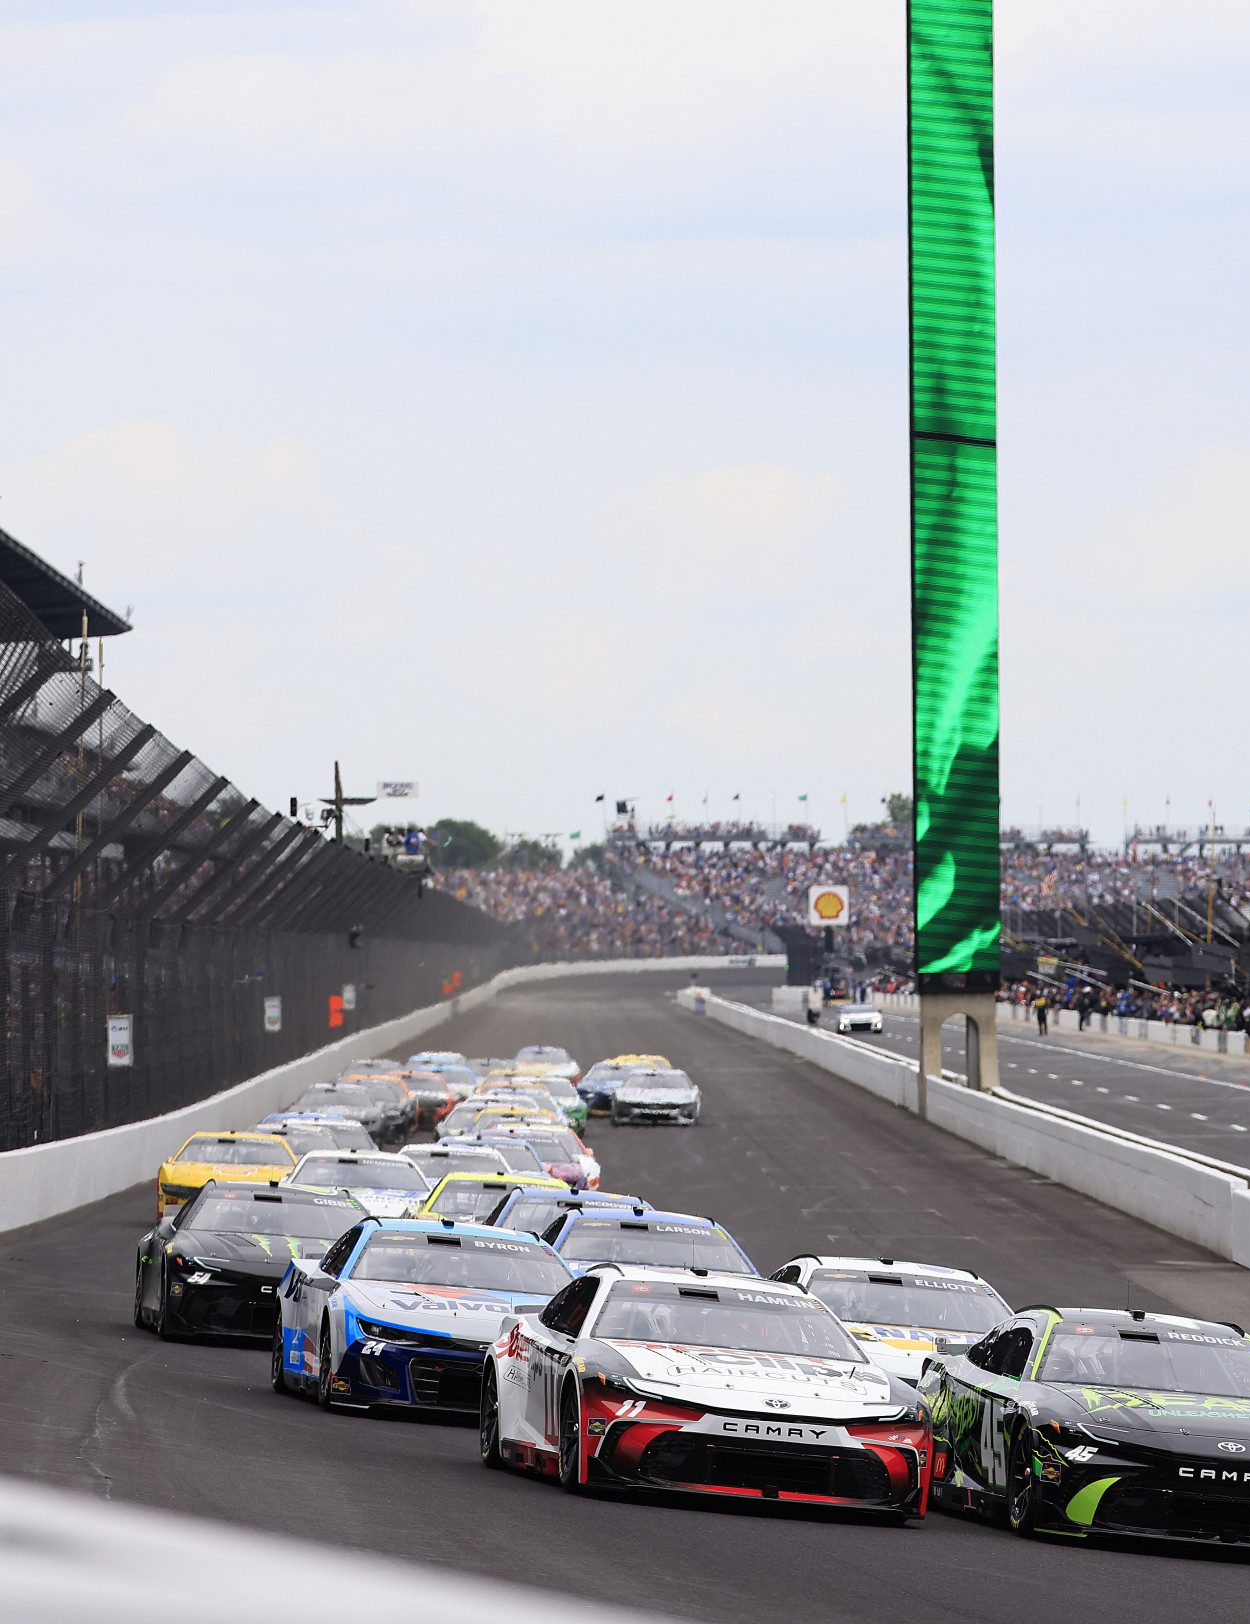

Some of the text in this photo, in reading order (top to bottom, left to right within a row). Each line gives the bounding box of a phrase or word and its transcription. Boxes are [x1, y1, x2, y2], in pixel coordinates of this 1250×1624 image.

[313, 1198, 353, 1209] GIBBS
[584, 1200, 636, 1210] MCDOW
[656, 1225, 711, 1236] LARSON
[474, 1240, 531, 1253] BYRON
[915, 1279, 978, 1293] ELLIOTT
[391, 1300, 511, 1314] Valvo
[738, 1293, 816, 1309] HAMLIN
[1167, 1332, 1247, 1347] REDDICK
[361, 1341, 387, 1356] 24
[615, 1400, 647, 1418] 11
[722, 1422, 827, 1440] CAMRY
[980, 1398, 1008, 1488] 45
[1065, 1445, 1099, 1462] 45
